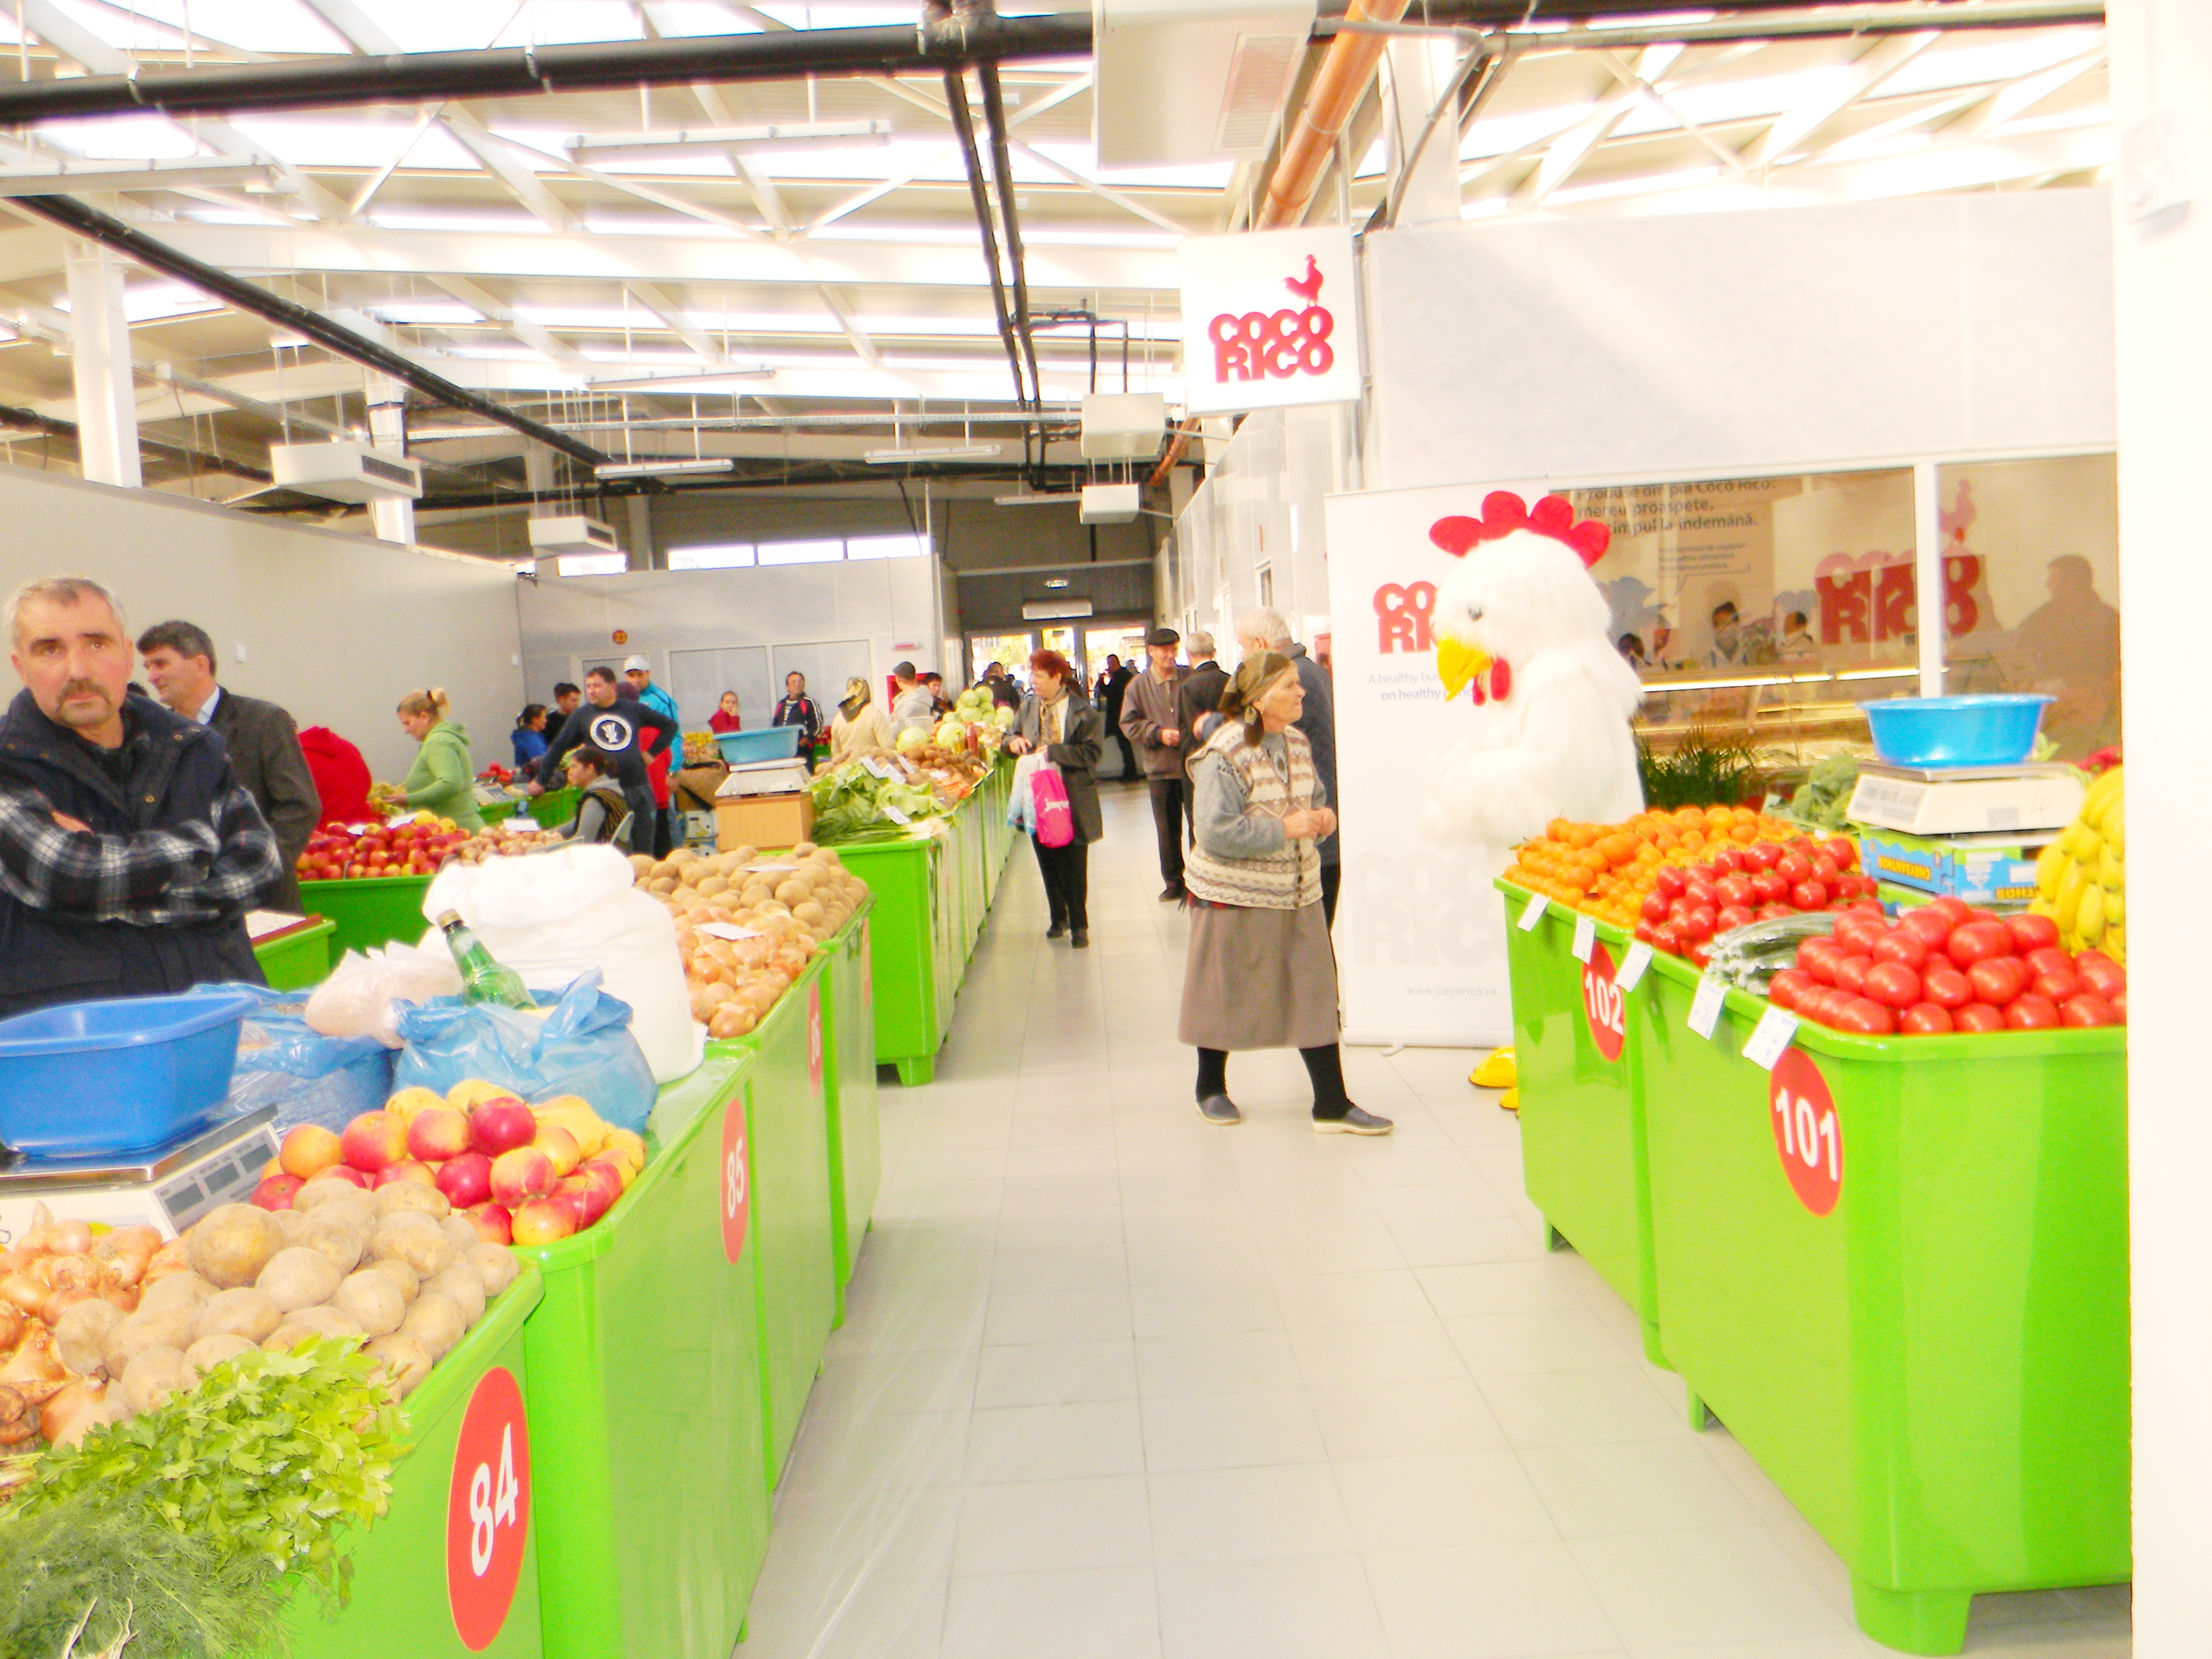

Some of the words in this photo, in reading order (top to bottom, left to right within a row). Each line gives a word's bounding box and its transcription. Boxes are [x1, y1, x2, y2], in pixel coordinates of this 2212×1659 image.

[1208, 306, 1334, 345] COCO
[1214, 341, 1334, 383] RICO
[1373, 581, 1438, 619] CO
[1378, 616, 1437, 654] RI
[1368, 674, 1376, 685] A
[1379, 672, 1418, 685] healthy
[1381, 691, 1396, 701] on
[1399, 688, 1441, 701] healthy
[1407, 988, 1497, 997] www.cocorico.ro
[1585, 971, 1624, 1036] 102
[1775, 1087, 1838, 1183] 101
[727, 1136, 745, 1219] 85
[469, 1422, 519, 1577] 84
